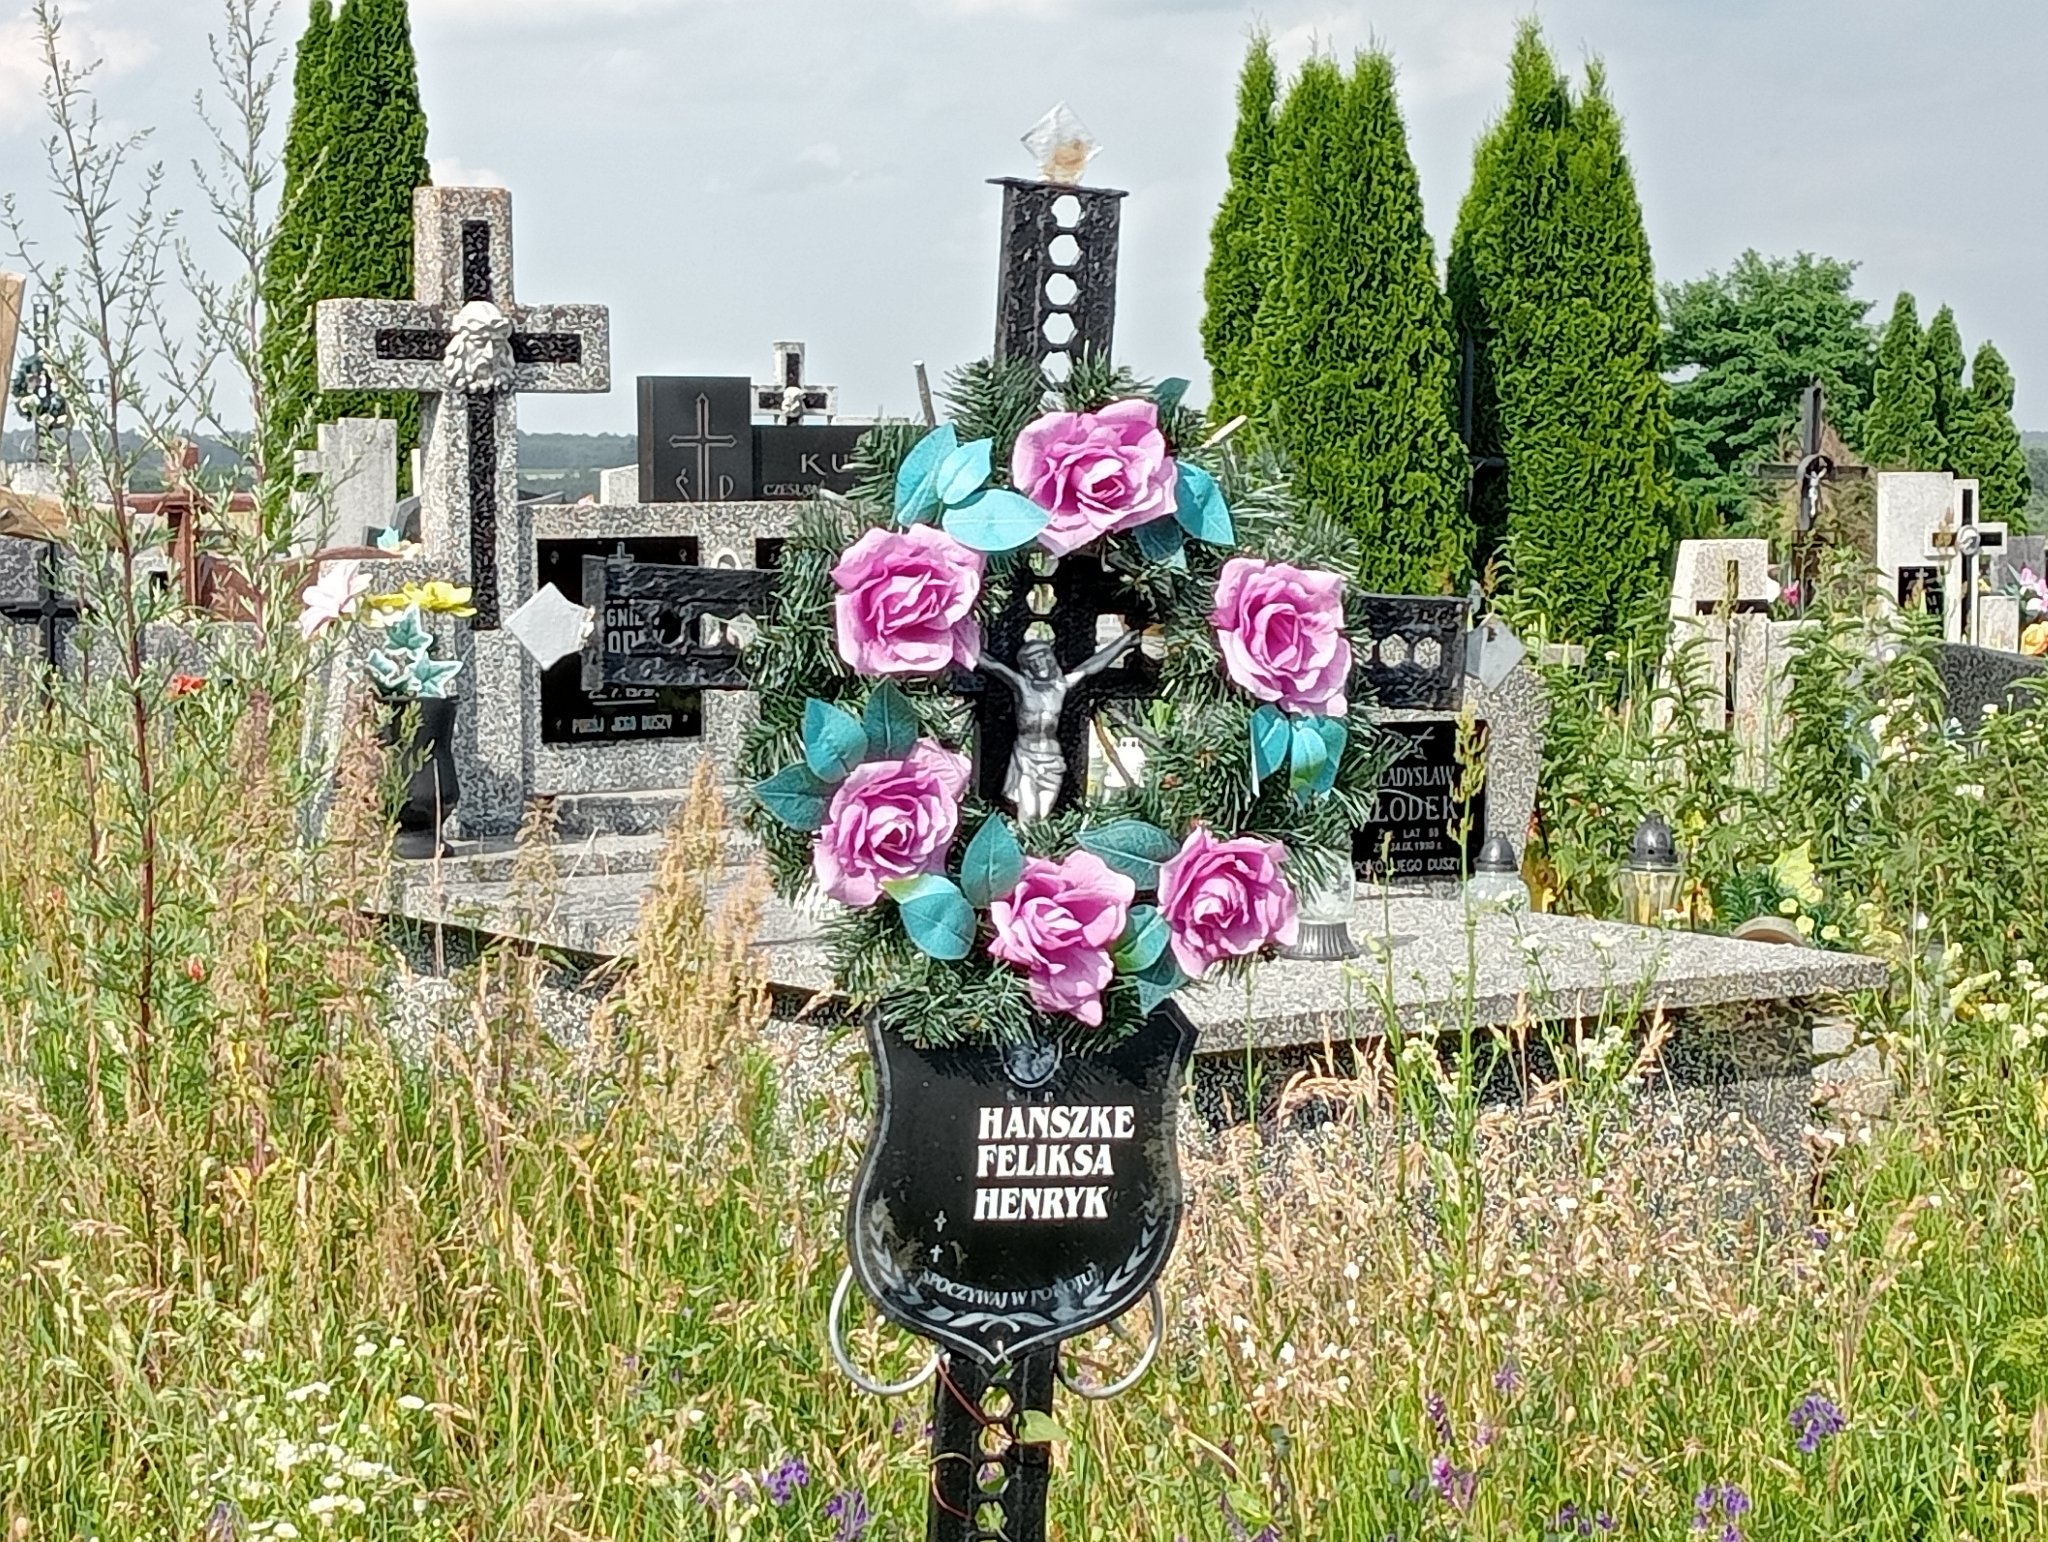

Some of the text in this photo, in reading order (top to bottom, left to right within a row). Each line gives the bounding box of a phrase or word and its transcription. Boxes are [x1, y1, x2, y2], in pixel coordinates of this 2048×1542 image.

[801, 453, 849, 475] KU
[1370, 795, 1458, 822] ŁODEK
[978, 1106, 1135, 1139] HANSZKE
[976, 1144, 1115, 1177] FELIKSA
[973, 1186, 1109, 1220] HENRYK
[1011, 1290, 1029, 1306] W
